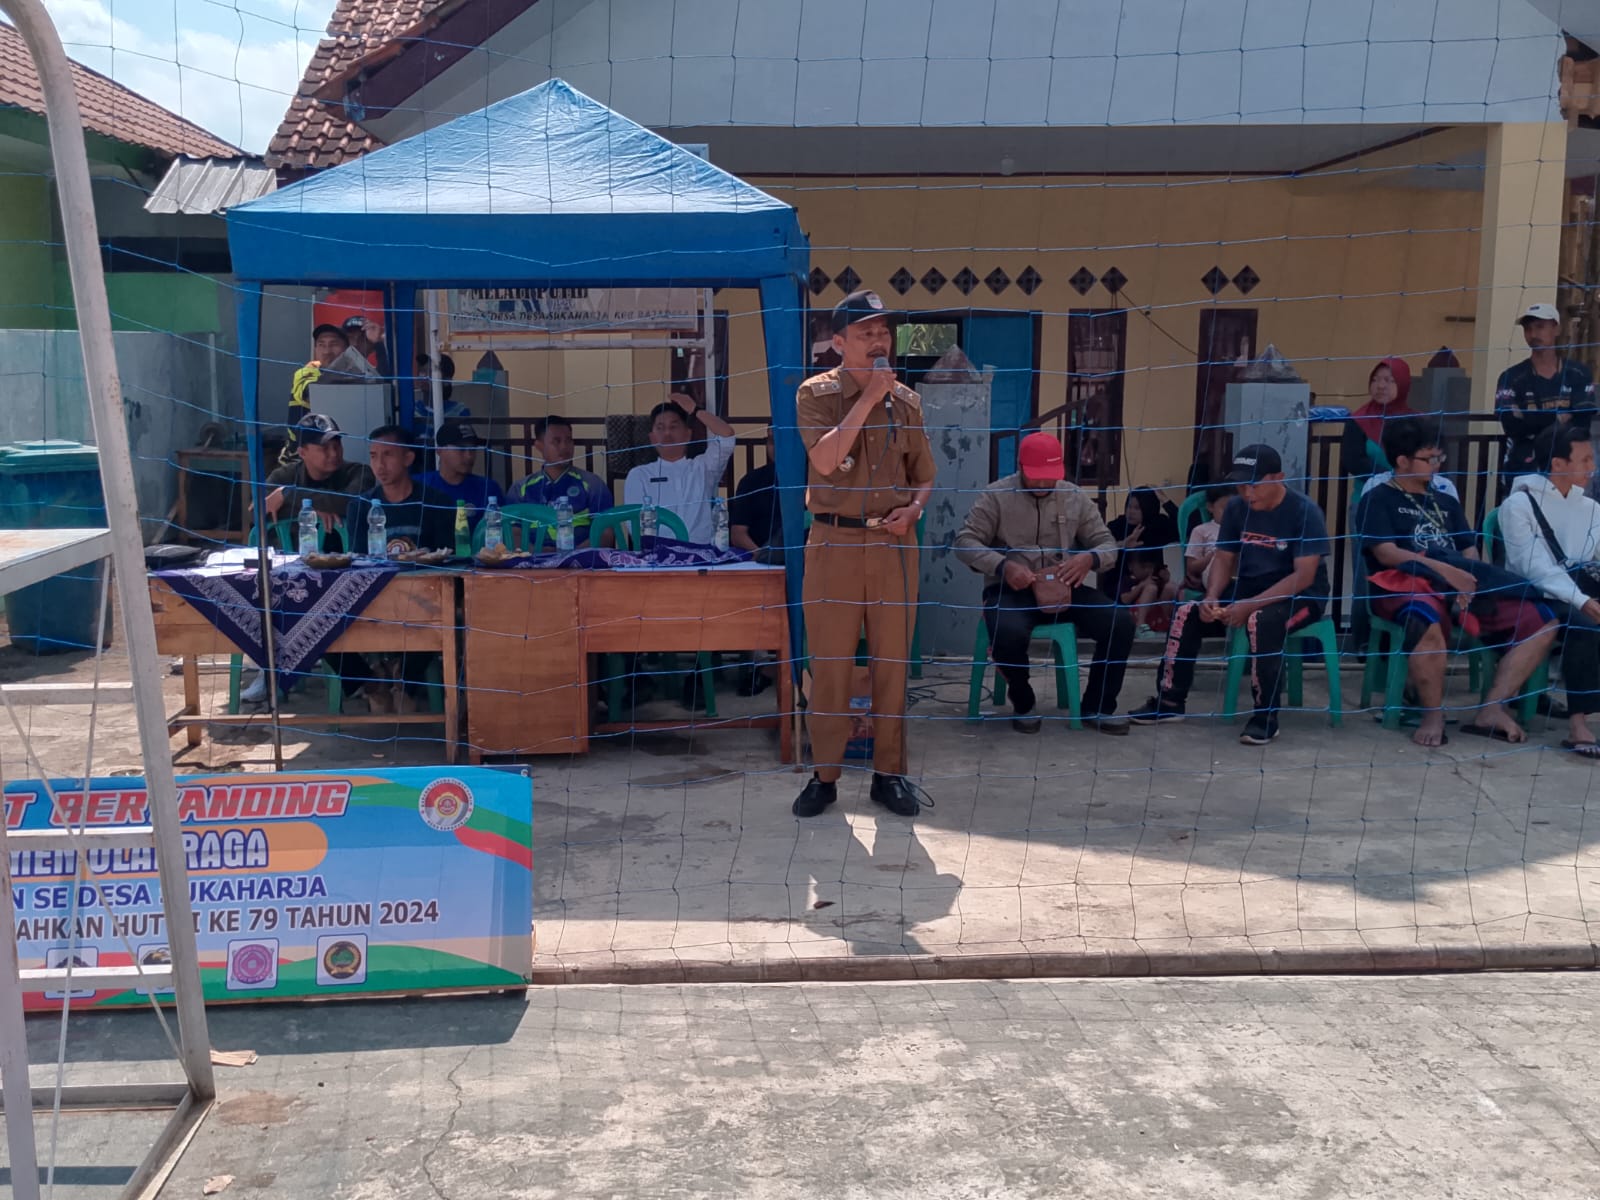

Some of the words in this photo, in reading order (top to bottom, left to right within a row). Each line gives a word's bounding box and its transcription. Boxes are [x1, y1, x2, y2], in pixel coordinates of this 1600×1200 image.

[5, 793, 37, 828] T
[50, 782, 351, 827] BERANDING
[11, 850, 77, 877] MEN
[88, 829, 269, 875] OLARAGA
[13, 889, 24, 910] N
[34, 887, 68, 909] SE
[80, 884, 150, 907] DESA
[160, 877, 327, 903] KAHARJA
[16, 916, 104, 941] AHKAN
[113, 913, 164, 937] HUT
[191, 911, 200, 933] I
[209, 910, 240, 932] KE
[249, 908, 278, 931] 79
[286, 903, 371, 928] TAHUN
[380, 900, 439, 924] 2024
